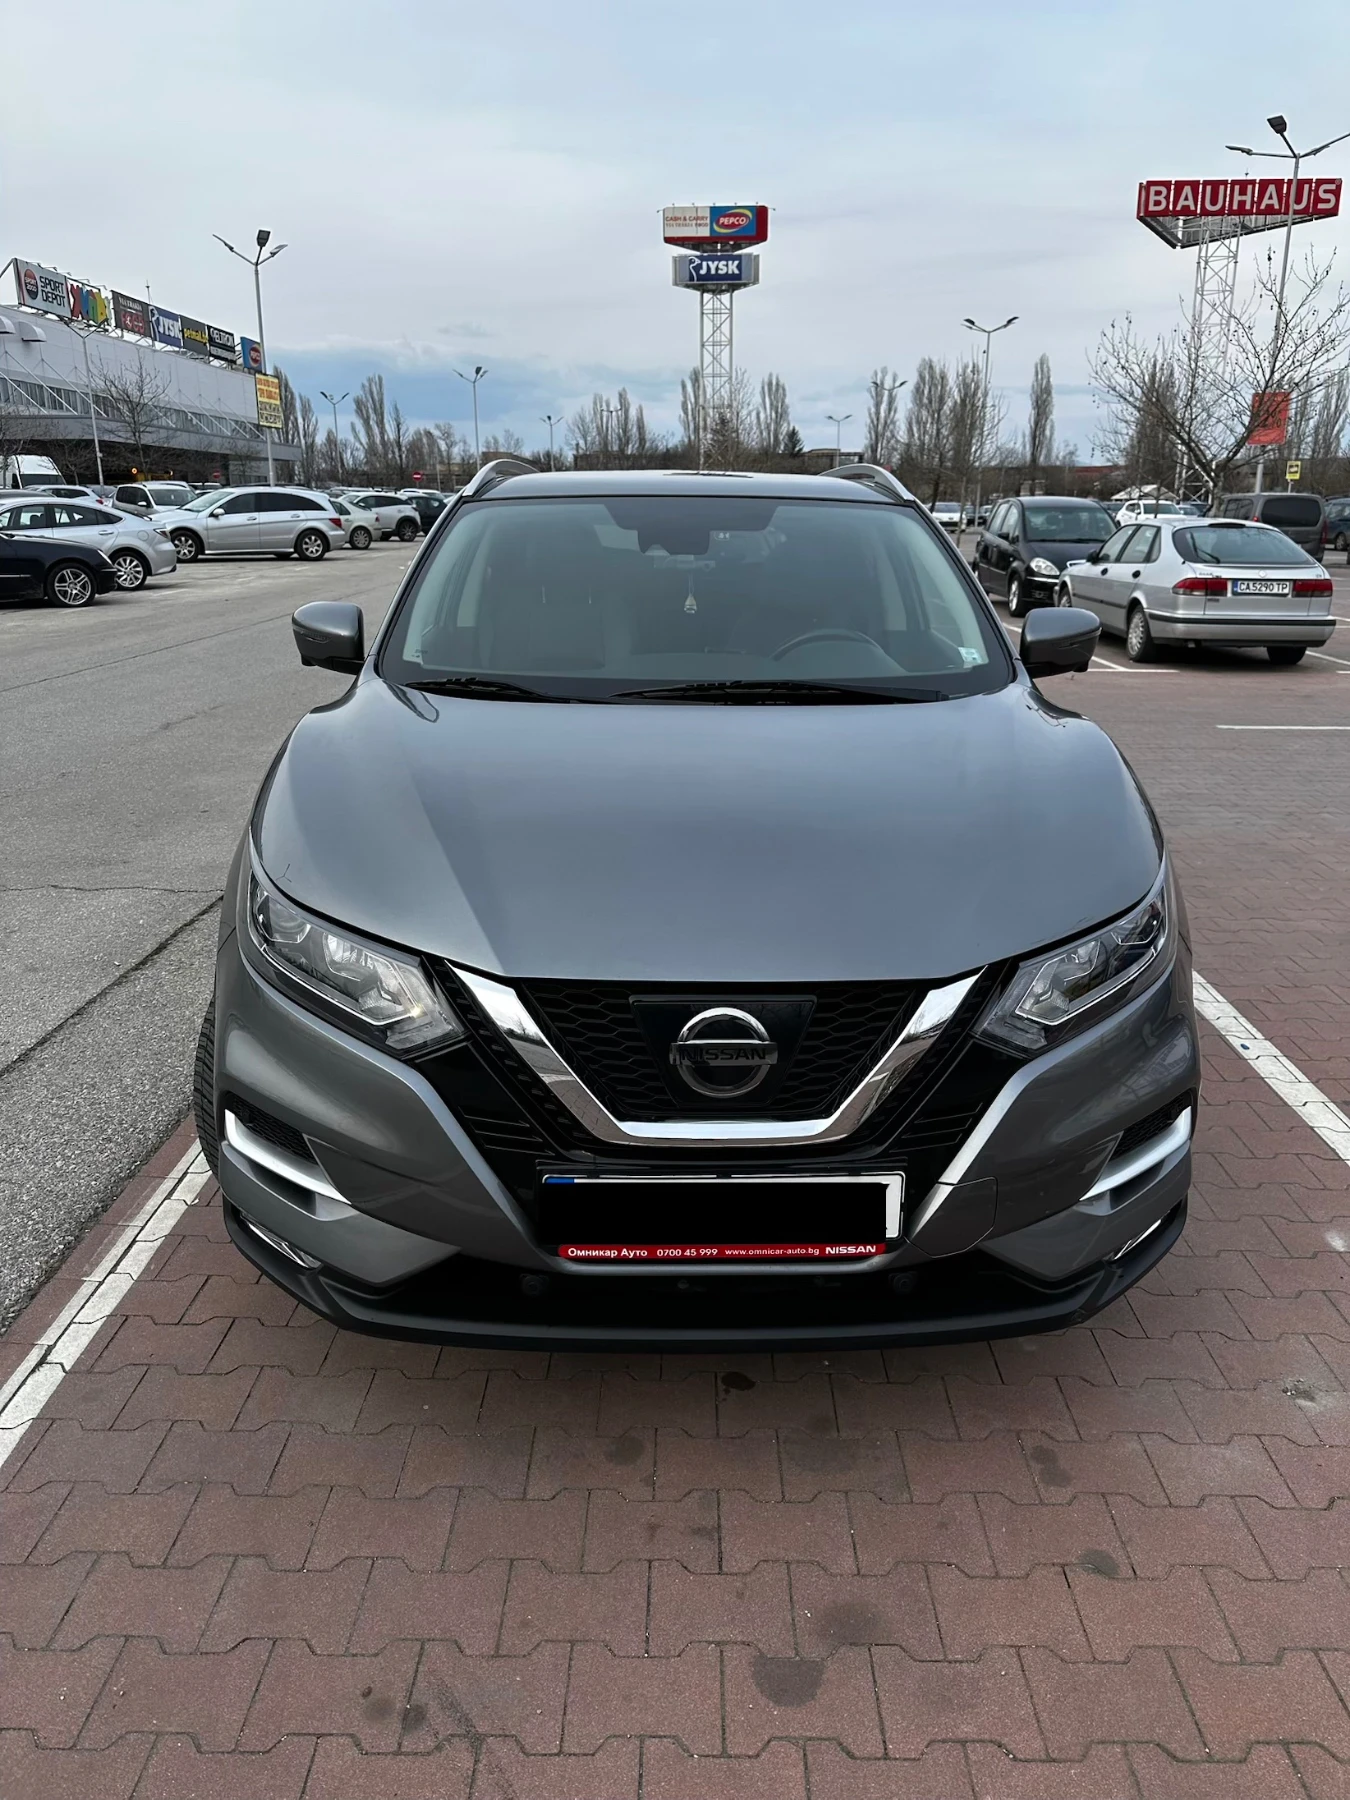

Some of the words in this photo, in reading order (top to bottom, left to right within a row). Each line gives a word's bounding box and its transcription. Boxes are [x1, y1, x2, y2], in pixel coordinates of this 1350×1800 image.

[1148, 183, 1337, 212] BAUHAUS
[719, 217, 746, 225] PEPCO
[699, 260, 740, 274] JYSK
[39, 275, 65, 295] SPORT
[41, 288, 66, 308] DEPOT
[157, 315, 181, 339] JYSK
[1276, 582, 1288, 592] TP
[681, 1048, 766, 1060] NISSAN
[567, 1248, 618, 1258] Омникар
[620, 1248, 648, 1259] Ауто
[656, 1249, 682, 1257] 0700
[699, 1248, 719, 1257] 999
[724, 1247, 820, 1256] www.omnicar-auto.bg
[825, 1245, 877, 1254] NISSAN
